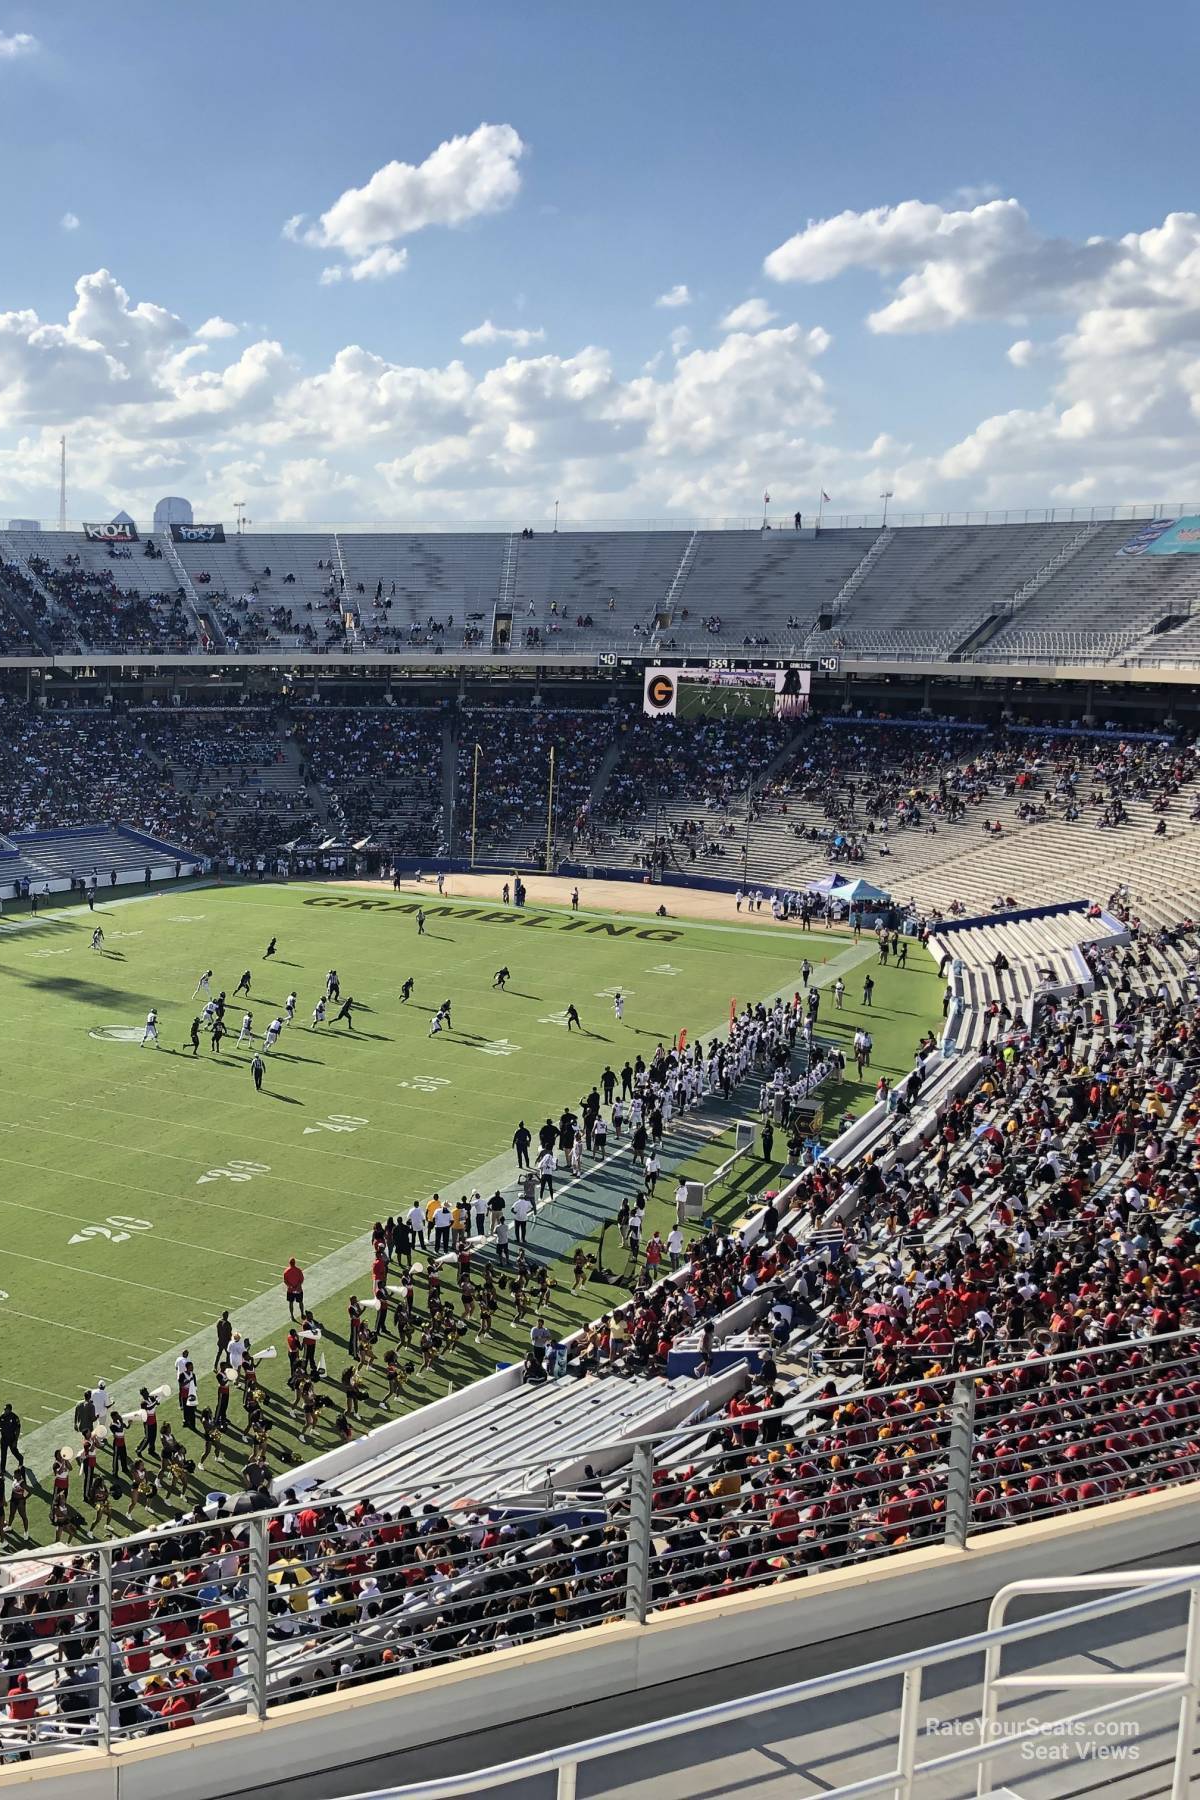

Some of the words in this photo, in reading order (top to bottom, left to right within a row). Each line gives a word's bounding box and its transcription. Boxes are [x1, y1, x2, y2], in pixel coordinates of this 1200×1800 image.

[600, 654, 616, 665] 40
[708, 660, 728, 669] 13:59
[775, 661, 784, 669] 17
[822, 659, 836, 670] 40
[648, 675, 674, 709] G
[302, 896, 685, 942] GRAMBLING
[476, 1042, 522, 1056] 40
[396, 1075, 452, 1092] 50
[316, 1114, 370, 1133] 40
[206, 1160, 272, 1182] 30
[80, 1215, 154, 1243] 20
